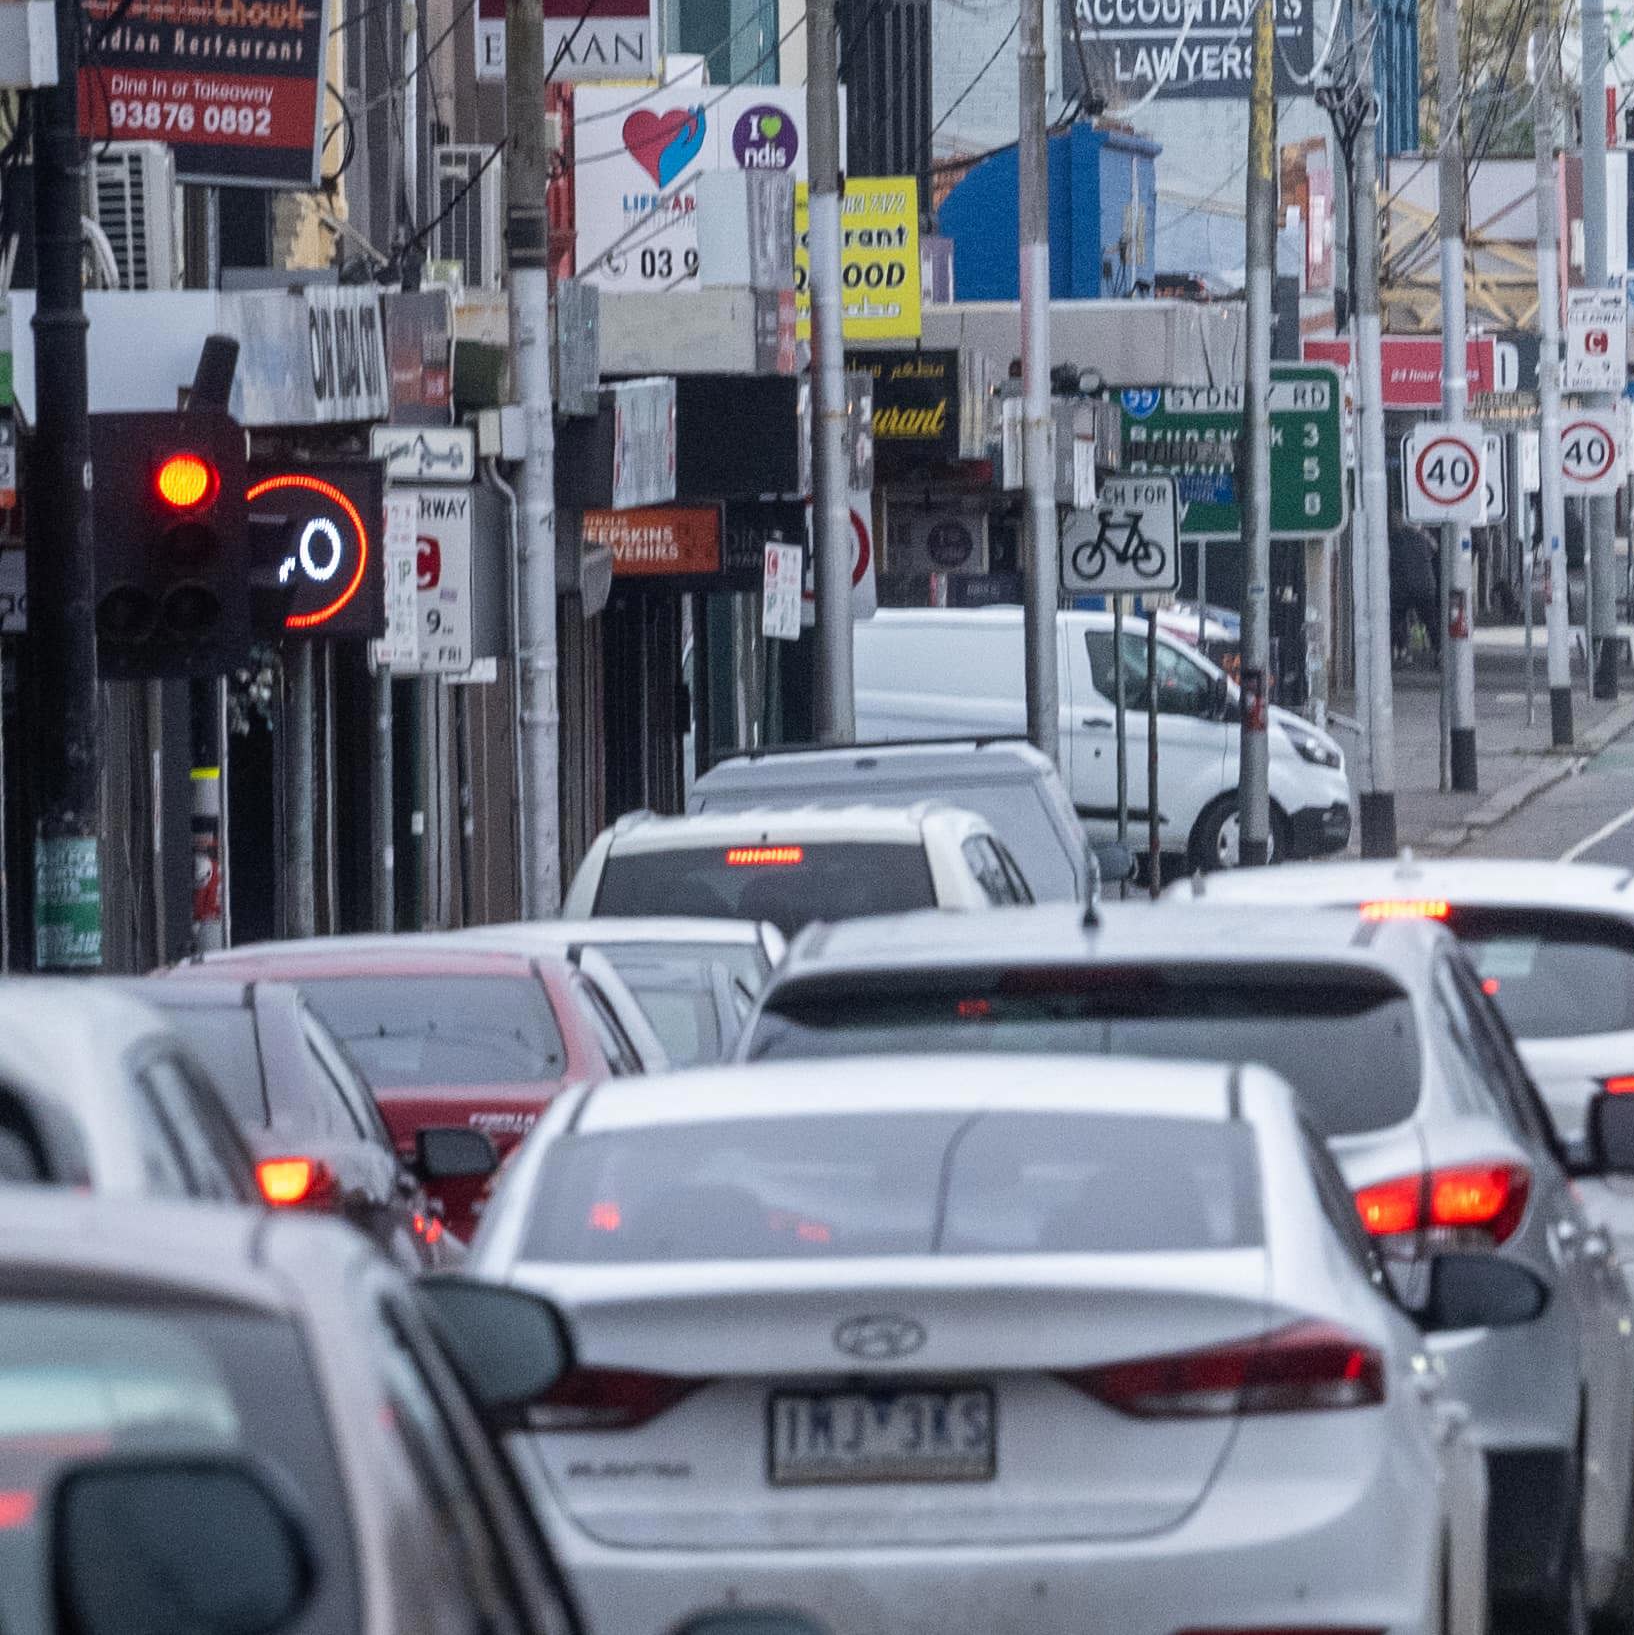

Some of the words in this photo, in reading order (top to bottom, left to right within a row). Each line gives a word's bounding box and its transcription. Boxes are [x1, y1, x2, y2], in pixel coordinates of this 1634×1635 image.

[174, 28, 304, 61] Restaurant
[111, 75, 147, 95] Dine
[172, 82, 189, 97] or
[194, 83, 274, 106] Takeaway
[110, 100, 196, 132] 93876
[203, 105, 273, 137] 0892
[641, 248, 673, 279] 03
[1294, 384, 1325, 402] RD
[1303, 422, 1320, 448] 3
[1564, 438, 1605, 466] 40
[1427, 457, 1469, 487] 40
